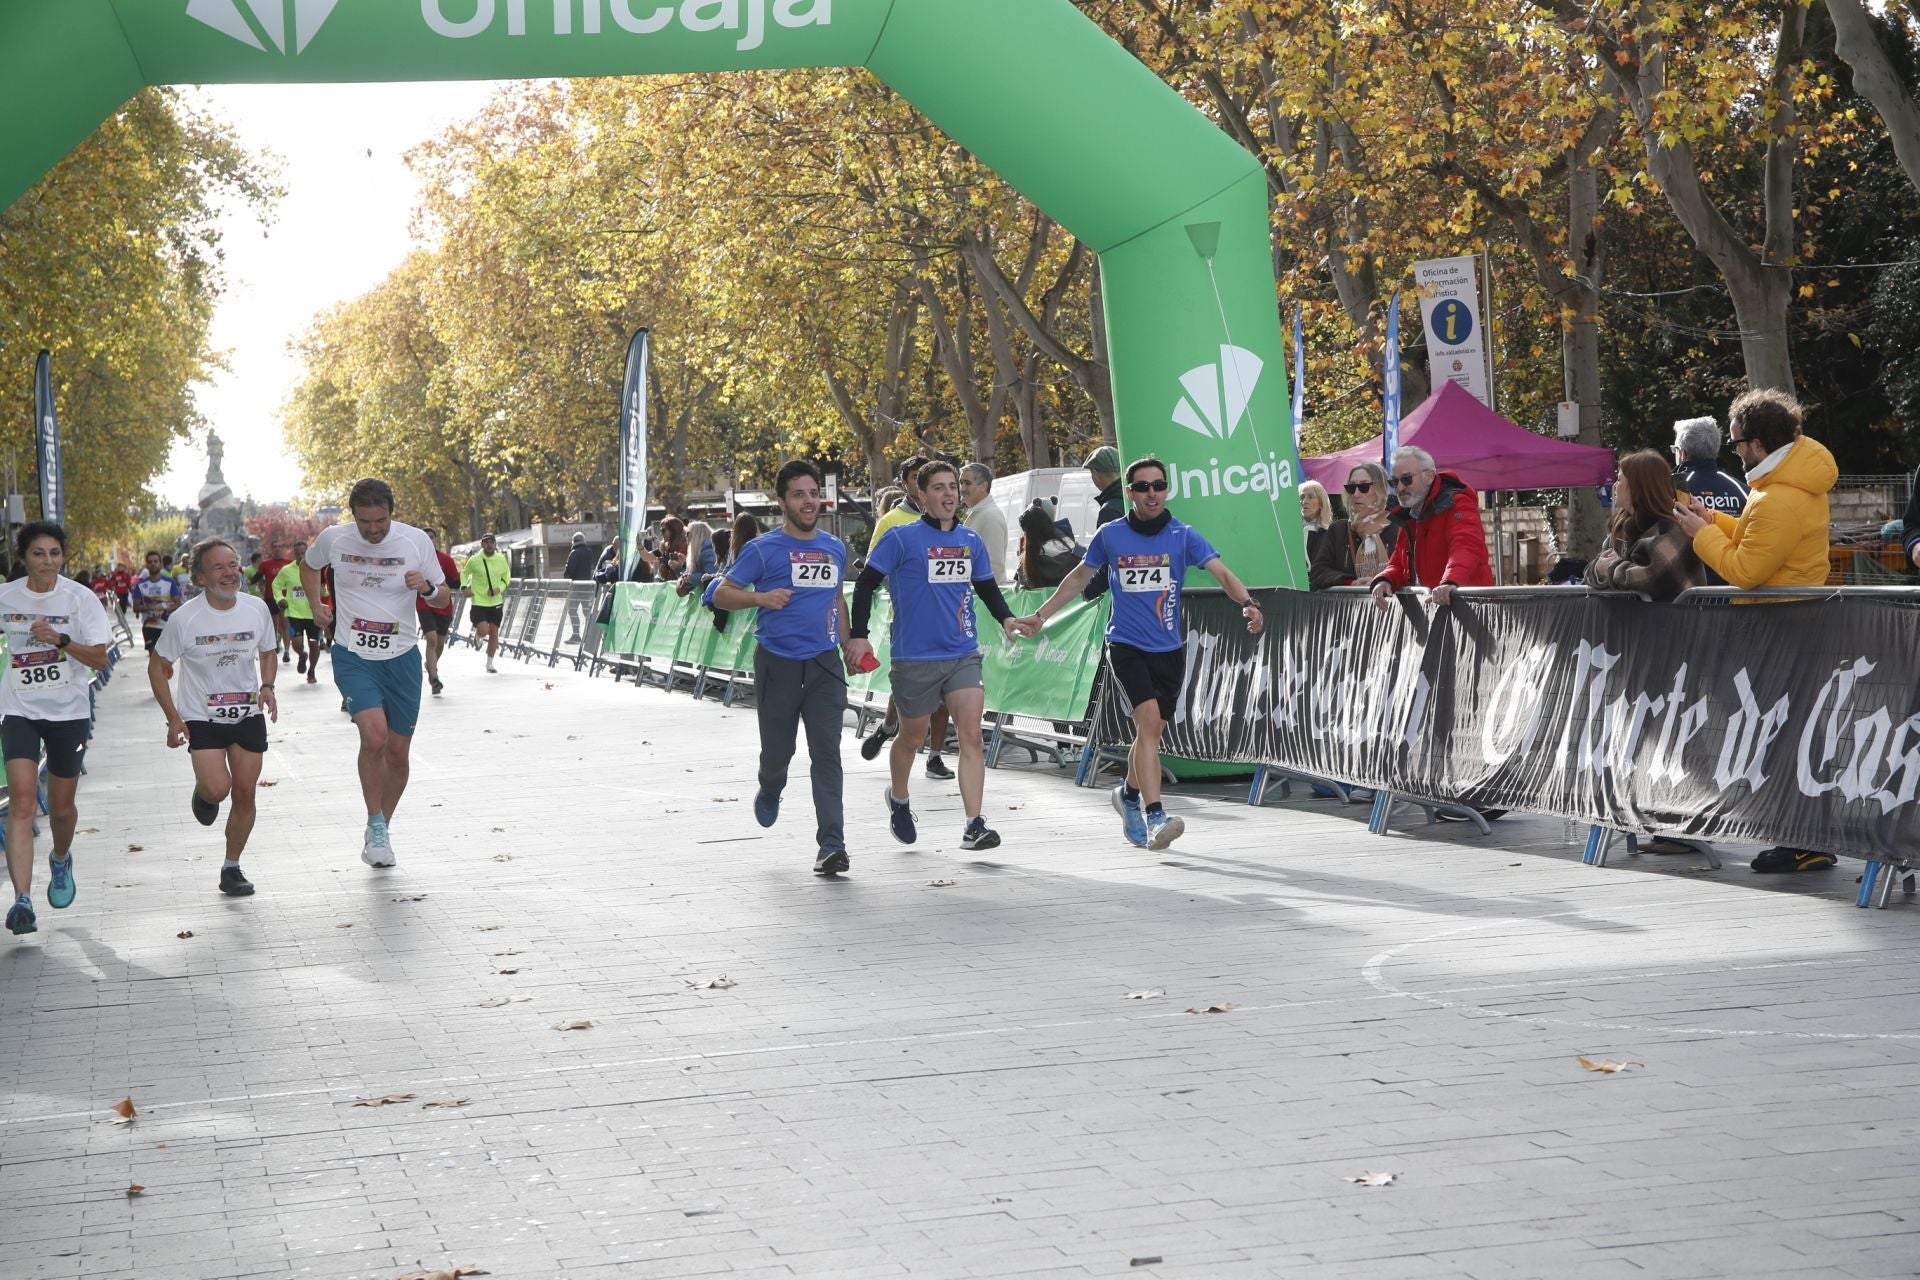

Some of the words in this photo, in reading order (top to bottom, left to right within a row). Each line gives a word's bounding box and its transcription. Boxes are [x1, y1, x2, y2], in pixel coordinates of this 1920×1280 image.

[1422, 267, 1448, 278] Oficina
[1449, 266, 1459, 275] de
[1424, 276, 1469, 288] Iormación
[43, 415, 57, 519] nicaja
[798, 564, 832, 580] 276
[935, 560, 966, 576] 275
[1125, 568, 1162, 585] 274
[355, 632, 391, 649] 385
[20, 664, 61, 685] 386
[215, 705, 252, 719] 387
[1553, 637, 1709, 789] Norte
[1712, 665, 1791, 794] de
